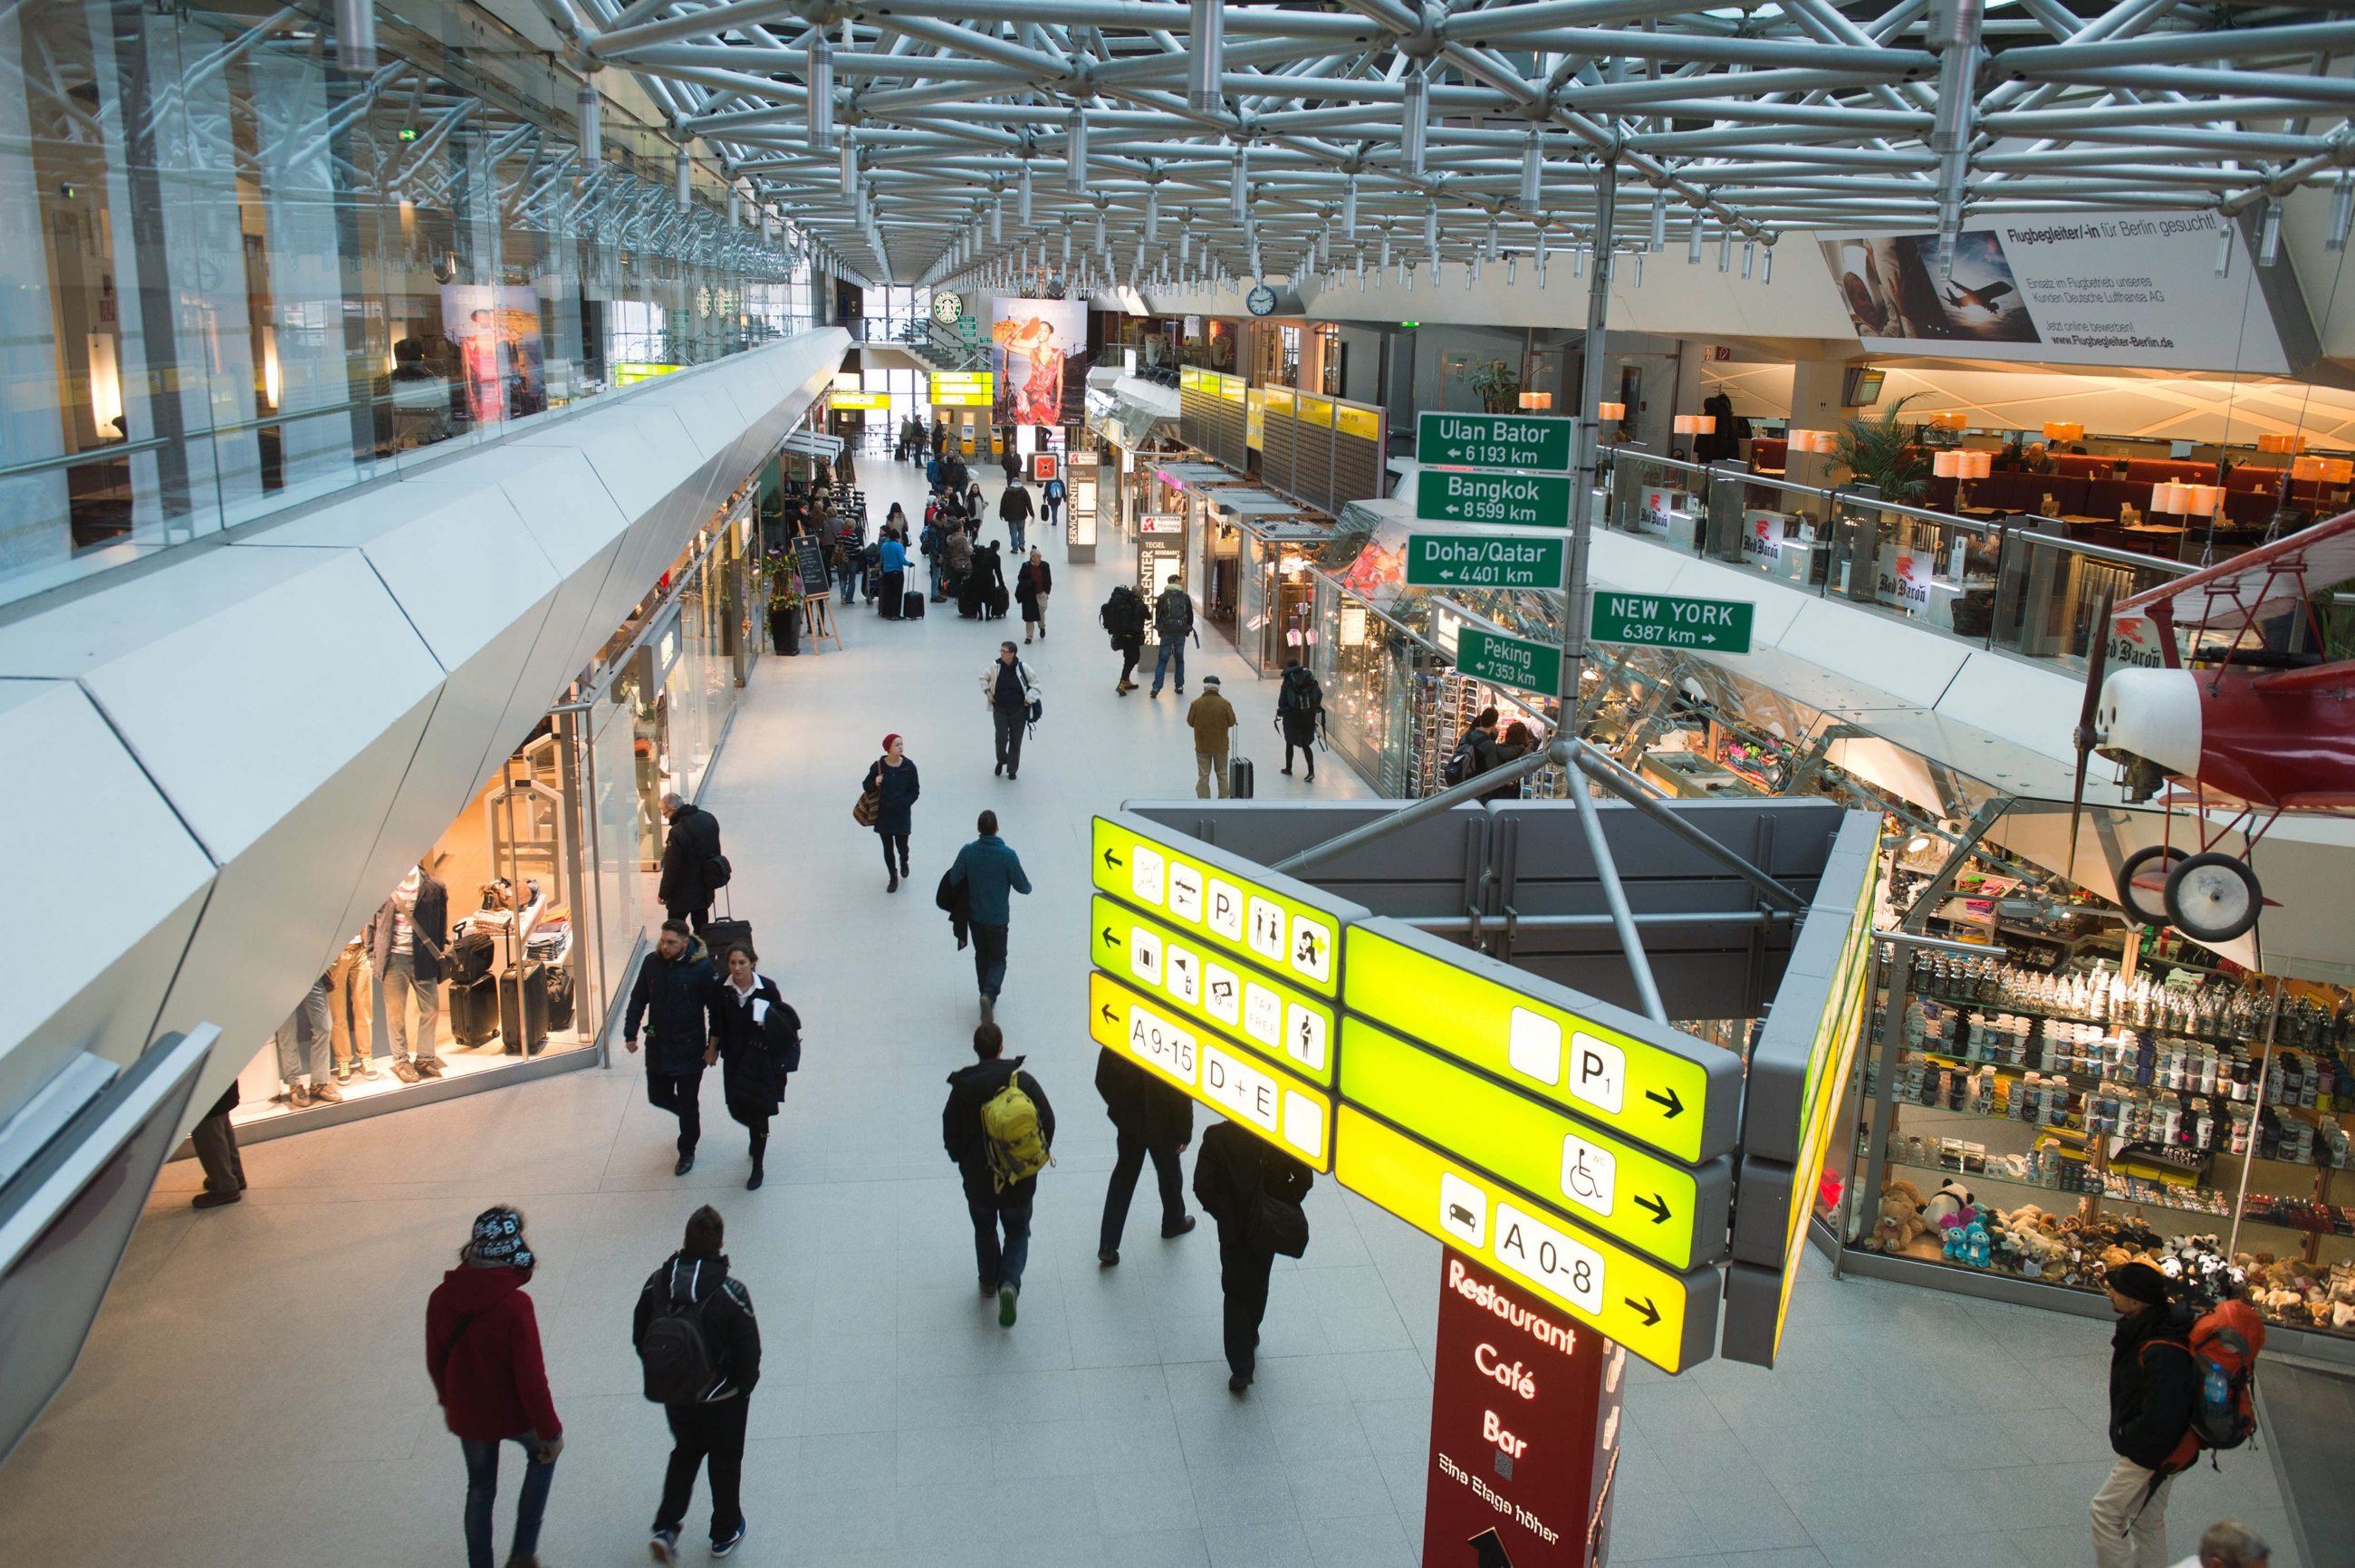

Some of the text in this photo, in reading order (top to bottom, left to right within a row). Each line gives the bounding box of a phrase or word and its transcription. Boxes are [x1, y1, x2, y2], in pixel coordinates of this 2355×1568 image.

[2007, 213, 2217, 245] Flugbegleiter/-in für Berlin gesucht!
[2026, 276, 2153, 291] Einsatz im Flugbetrieb unseres
[2032, 290, 2165, 303] Kunden Deutsche Lufthansa AG
[2045, 320, 2136, 333] Jetzt online bewerben!
[2051, 335, 2174, 349] www.Flugbegleiter-Berlin.de
[1440, 419, 1551, 444] Ulan Bator
[1511, 447, 1538, 465] km
[1447, 476, 1540, 503] Bangkok
[1069, 476, 1078, 544] SERVICECENTER
[1510, 504, 1536, 522] km
[1640, 507, 1652, 523] Red
[1425, 541, 1547, 563] Doha/Qatar
[1744, 534, 1757, 553] Red
[1506, 567, 1533, 583] km
[1879, 572, 1897, 593] Red
[1610, 597, 1734, 627] NEW YORK
[1623, 623, 1696, 645] 6387 km
[1484, 637, 1532, 669] Peking
[1517, 668, 1536, 687] km
[1254, 996, 1273, 1014] TAX
[1249, 1013, 1275, 1035] FREE
[1133, 1019, 1193, 1072] A 9-15
[1209, 1059, 1225, 1089] D
[1256, 1085, 1271, 1118] E
[1504, 1223, 1592, 1295] A 0-8
[1449, 1258, 1577, 1355] Restaurant
[1475, 1342, 1536, 1400] Café
[1483, 1409, 1528, 1458] Bar
[1438, 1452, 1559, 1546] Eine Etage höher
